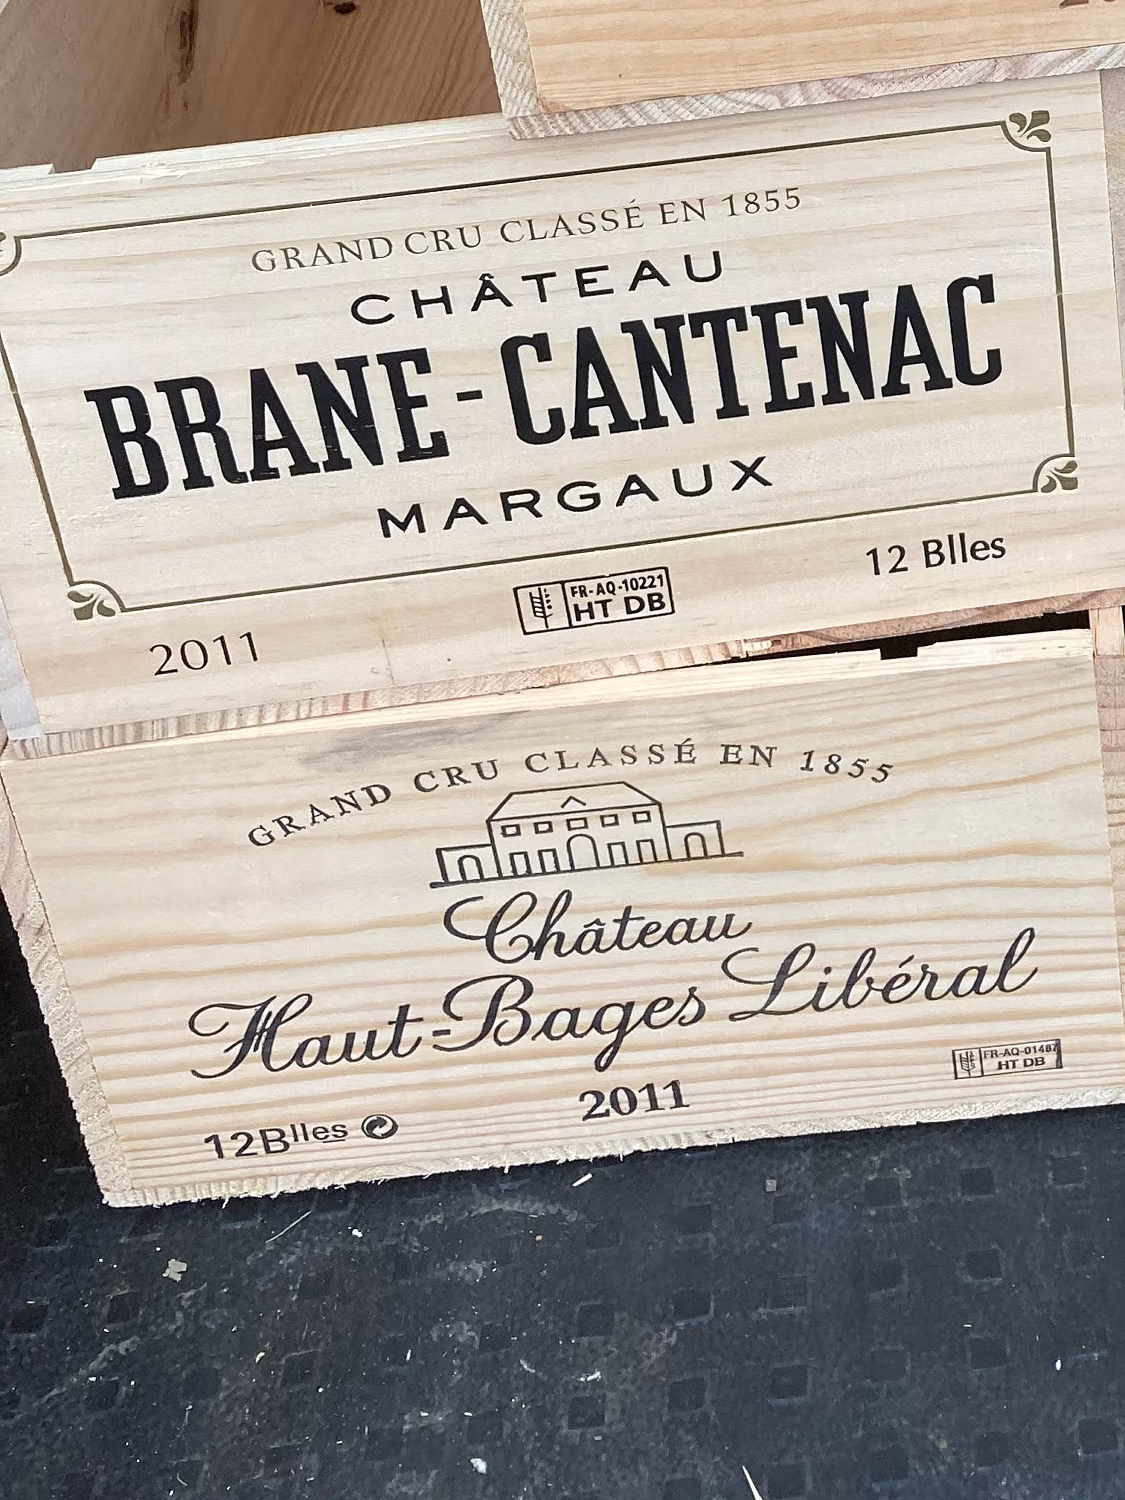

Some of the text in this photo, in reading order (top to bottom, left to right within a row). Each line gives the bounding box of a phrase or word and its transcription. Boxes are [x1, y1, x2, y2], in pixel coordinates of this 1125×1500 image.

[251, 187, 801, 273] GRAND CRU CLASSÉ EN 1855
[350, 250, 723, 325] CHÂTEAU
[377, 456, 773, 538] MARGAUX
[865, 545, 909, 576] 12
[573, 598, 613, 622] HT
[624, 592, 667, 615] DB
[149, 631, 259, 676] 2011
[247, 738, 894, 849] GRAND CRU CLASSÉ EN 1855
[443, 889, 753, 964] Château
[188, 926, 1039, 1079] Haut-Bages Libéral
[578, 1078, 691, 1122] 2011
[997, 1056, 1046, 1071] HT DB
